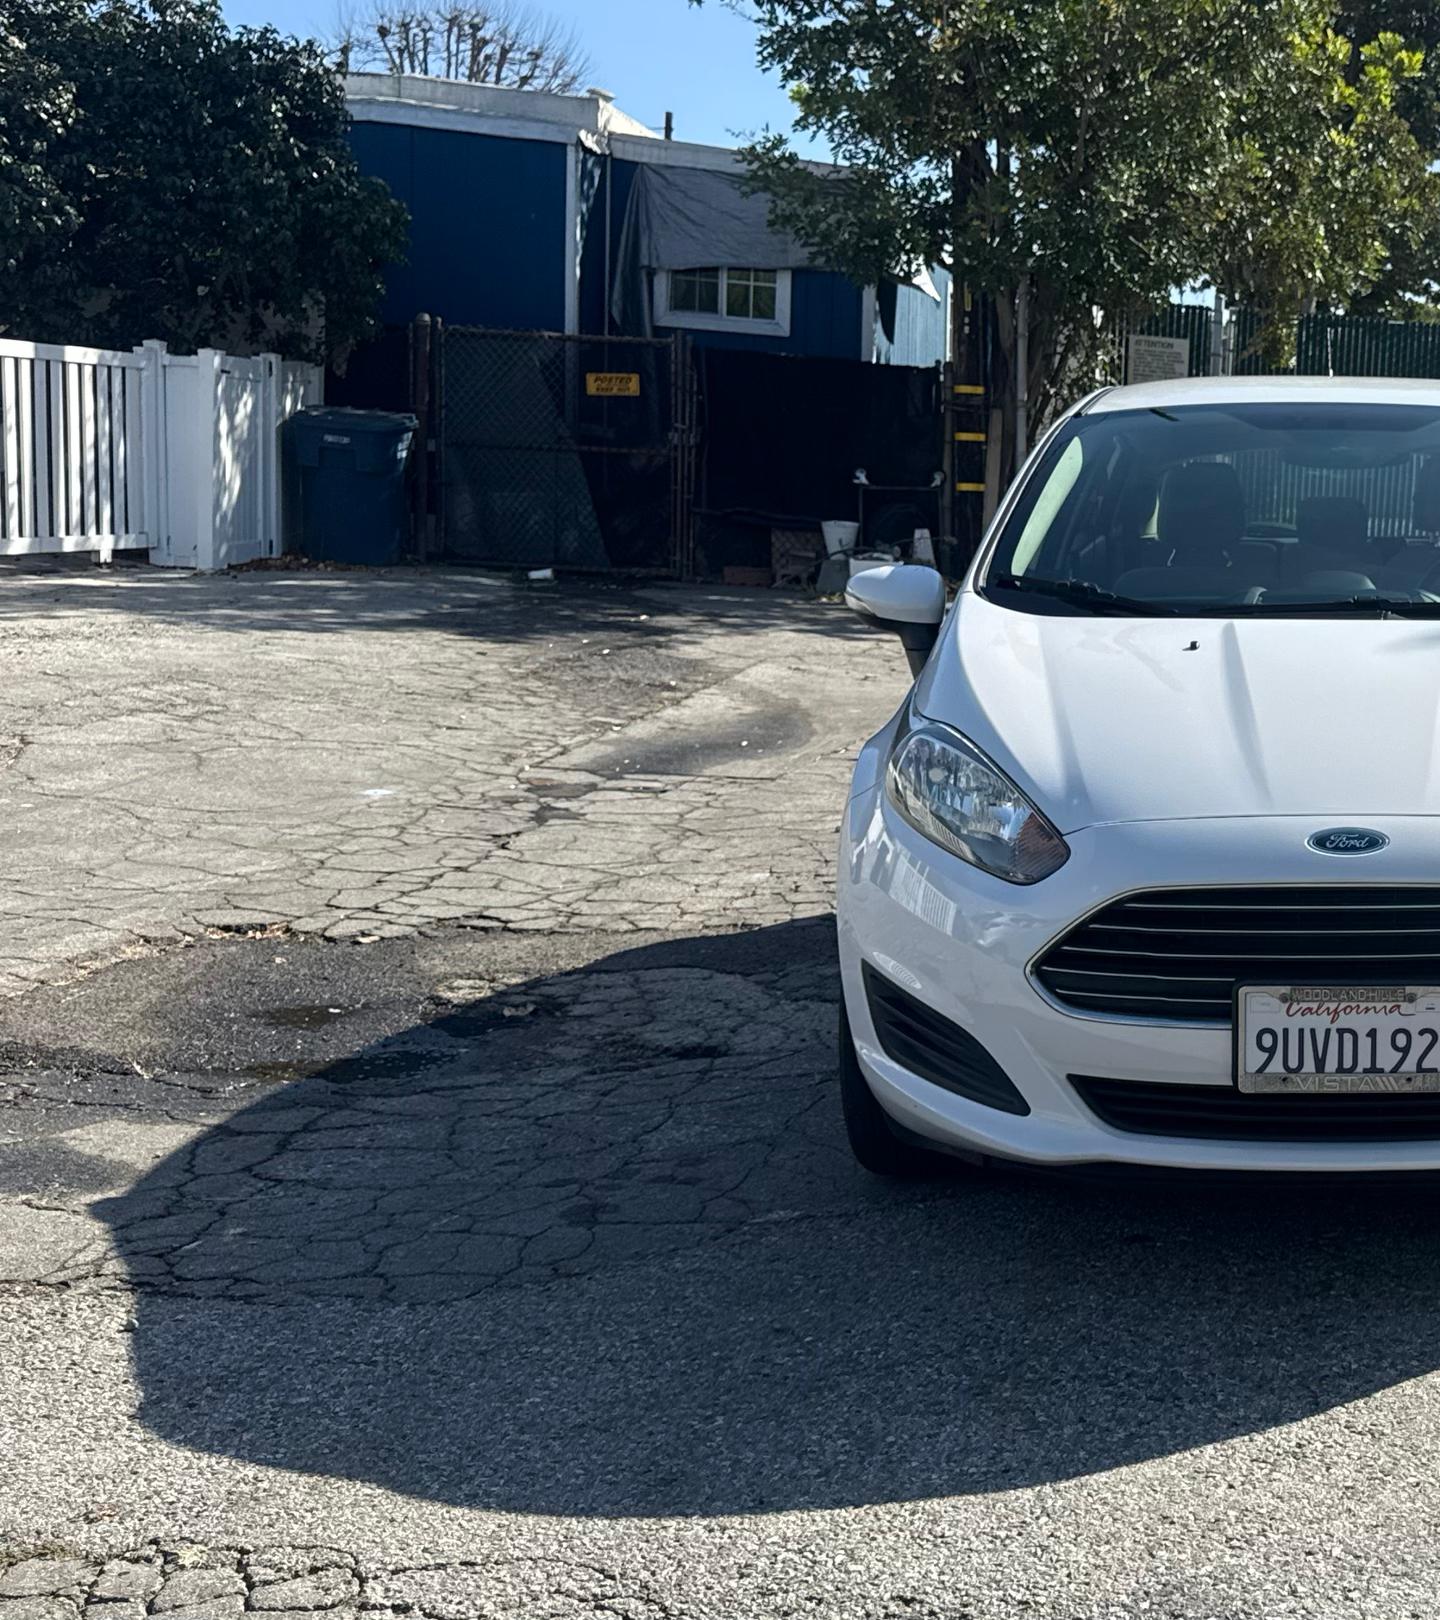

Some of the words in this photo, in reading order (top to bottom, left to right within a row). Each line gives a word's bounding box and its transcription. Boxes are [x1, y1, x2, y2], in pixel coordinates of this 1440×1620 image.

[594, 376, 632, 384] POSTED
[1326, 833, 1370, 848] Ford
[1292, 989, 1367, 1002] WOODLAND
[1286, 1001, 1415, 1024] California
[1255, 1027, 1439, 1074] 9UVD192
[1296, 1076, 1377, 1091] VISTA
